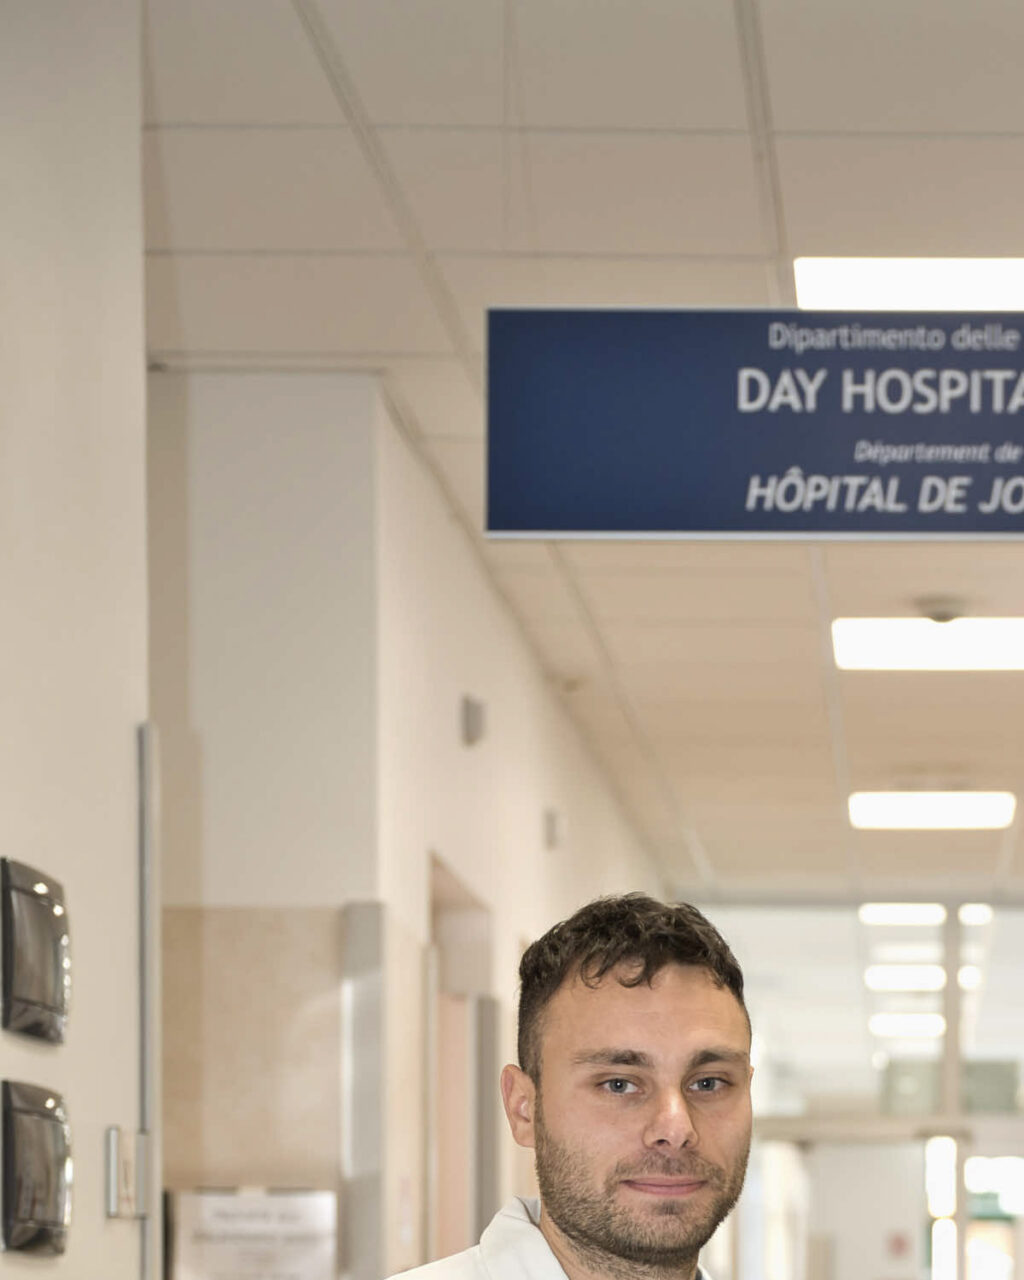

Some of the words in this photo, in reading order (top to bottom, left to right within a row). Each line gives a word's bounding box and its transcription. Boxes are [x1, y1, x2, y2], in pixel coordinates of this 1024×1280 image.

[769, 322, 946, 353] Dipartimento
[951, 323, 1020, 350] delle
[738, 369, 827, 412] DAY
[854, 440, 990, 465] Département
[995, 442, 1023, 462] de
[746, 466, 908, 513] HÔPITAL
[917, 476, 973, 513] DE
